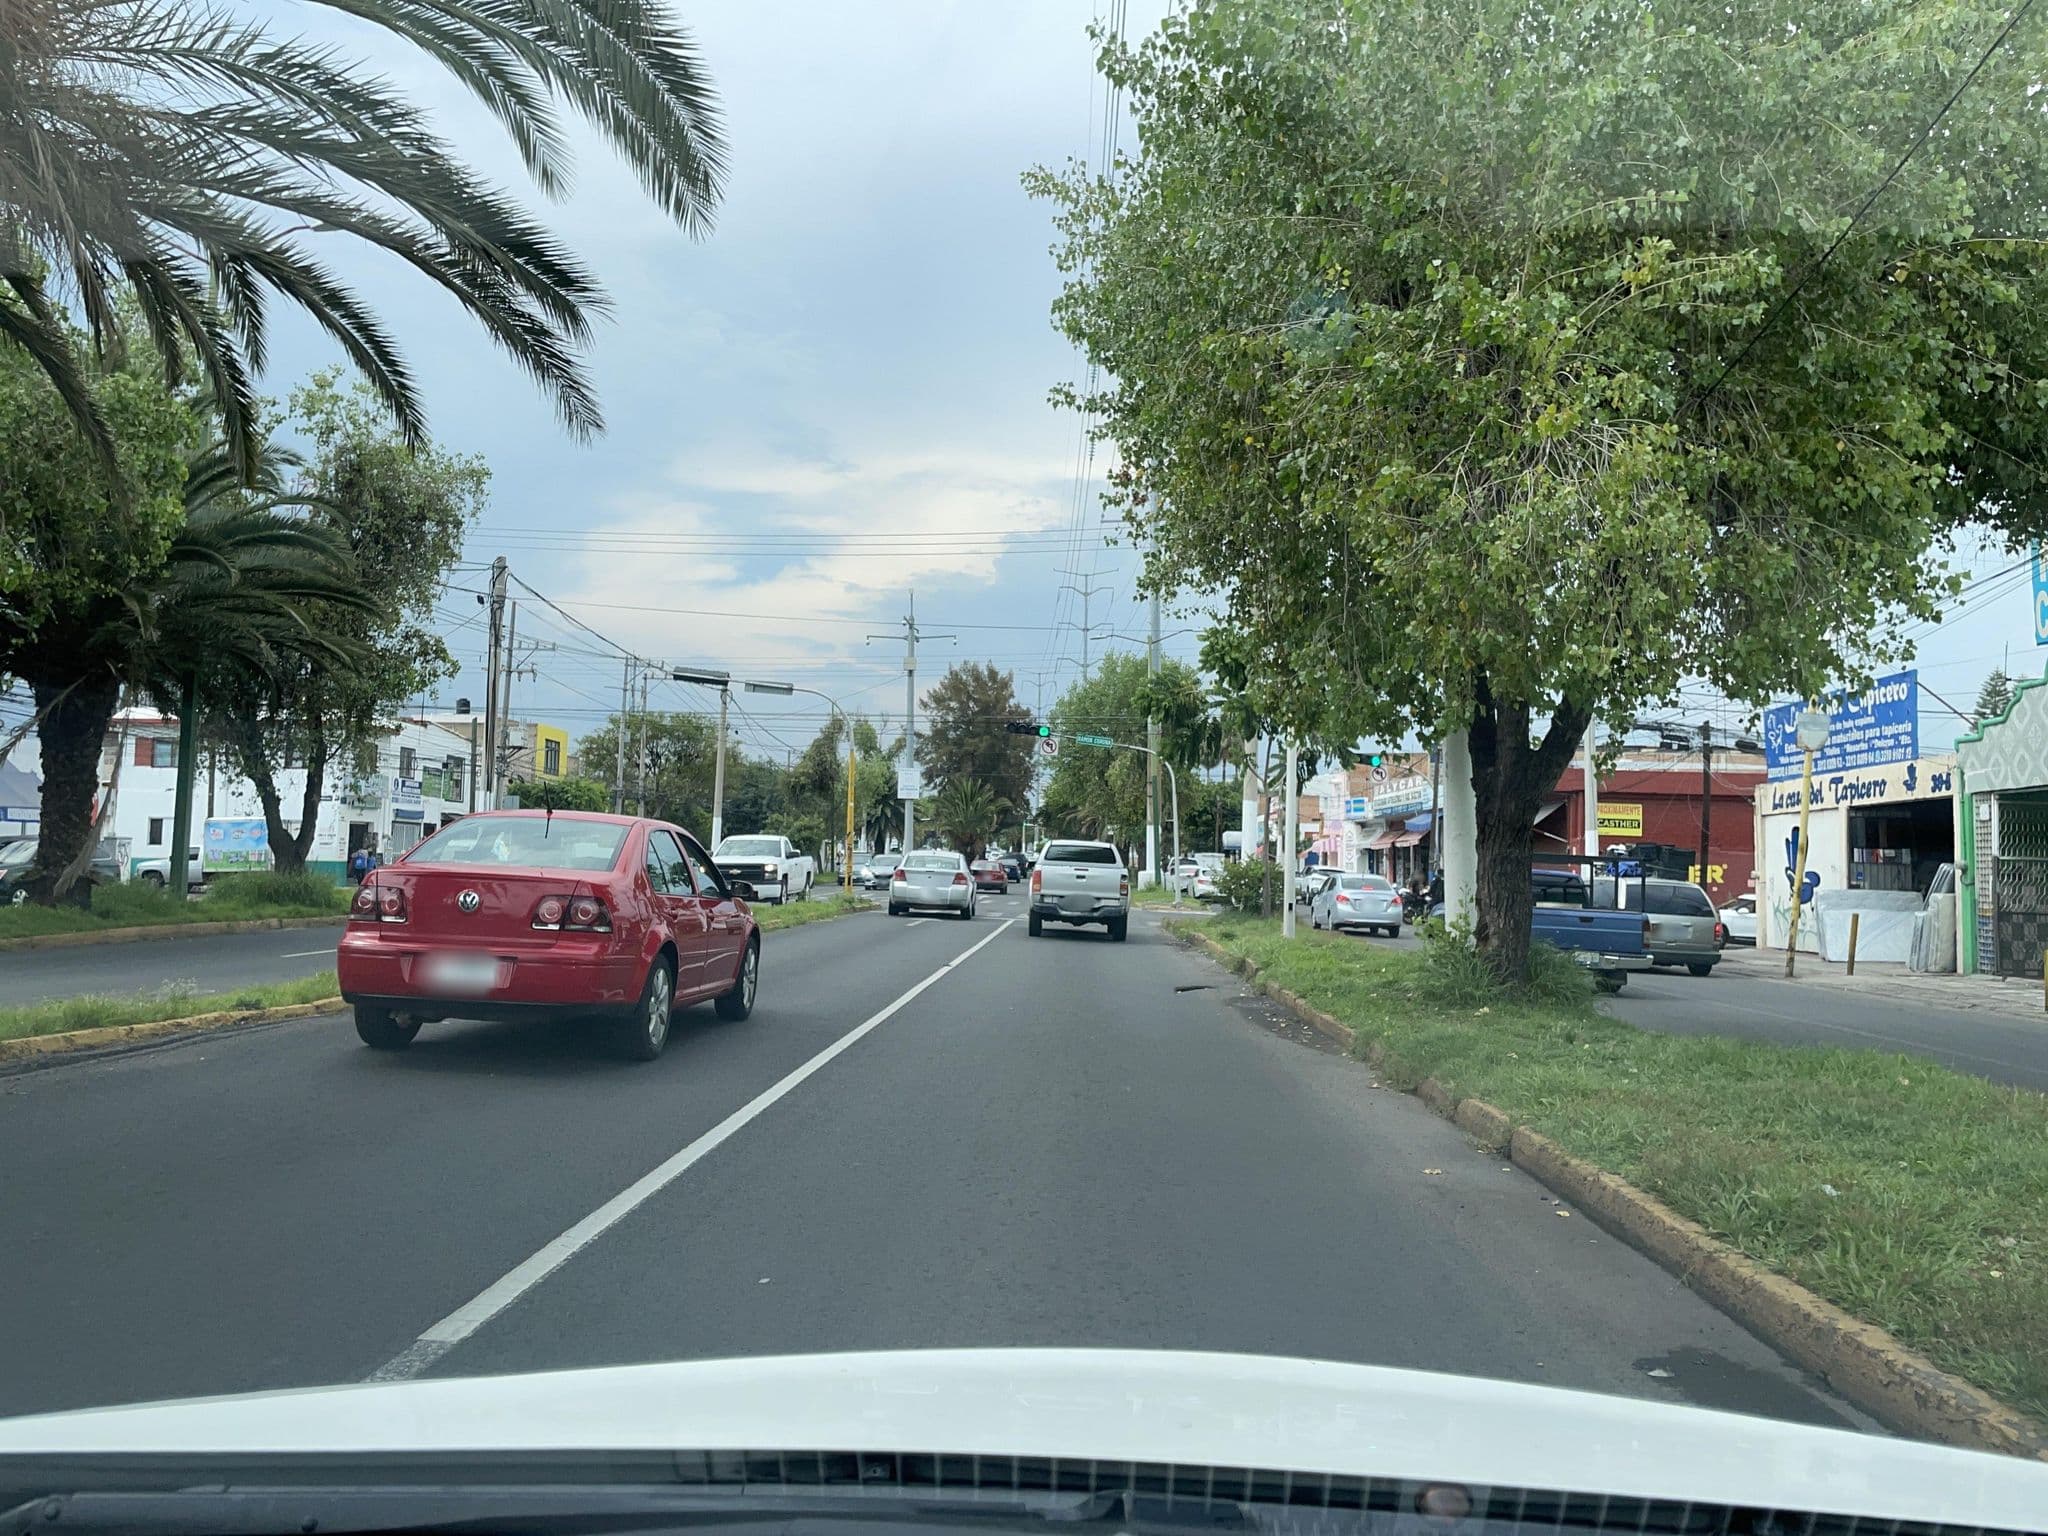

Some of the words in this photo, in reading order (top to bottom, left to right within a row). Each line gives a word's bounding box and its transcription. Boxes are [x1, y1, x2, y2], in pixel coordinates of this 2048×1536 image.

[1865, 727, 1880, 741] para
[1772, 786, 1784, 811] La
[1828, 775, 1888, 805] Tapicero
[1597, 804, 1641, 816] ROXIMAMENTE
[1597, 819, 1640, 828] CASTHER
